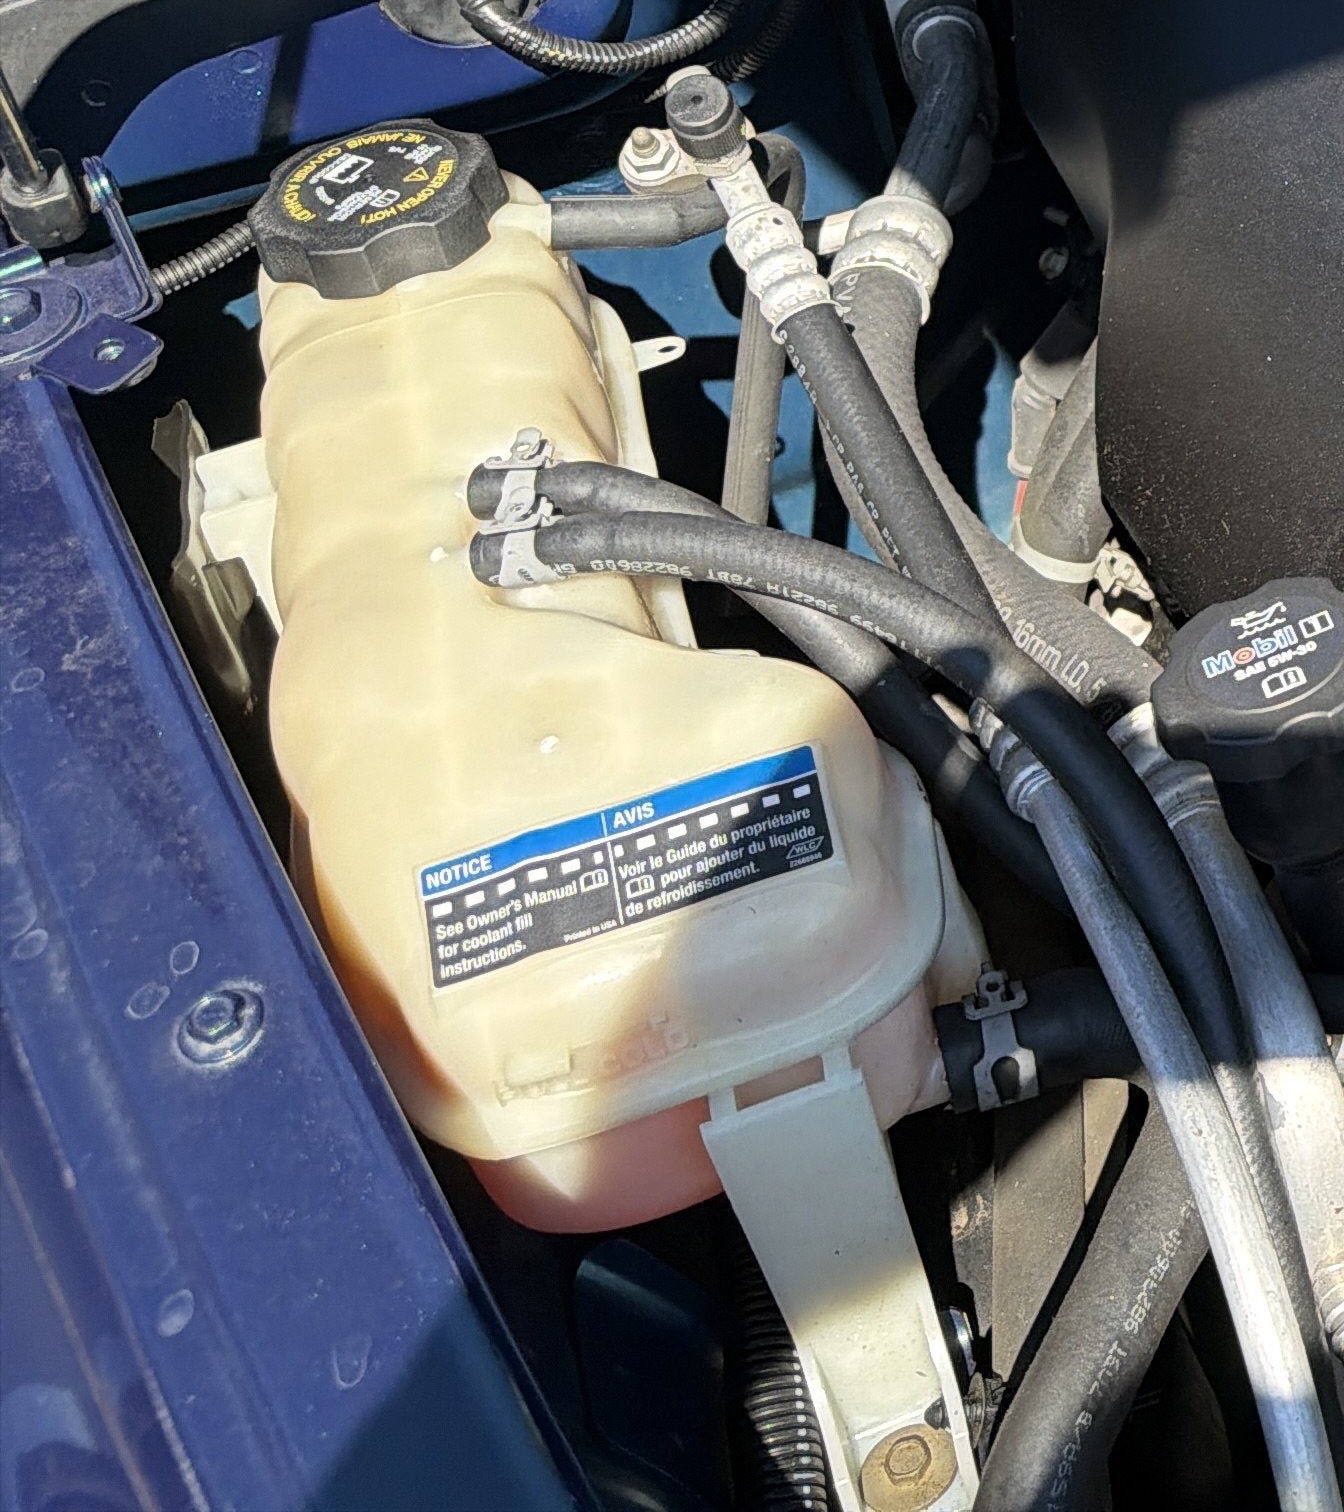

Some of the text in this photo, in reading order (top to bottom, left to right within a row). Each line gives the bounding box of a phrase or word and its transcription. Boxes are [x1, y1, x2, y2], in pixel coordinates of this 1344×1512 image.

[1201, 624, 1298, 679] Mobil
[1233, 640, 1318, 681] SAE 5W-30
[612, 802, 655, 829] AVIS
[618, 807, 811, 879] Voir le Guide du propriétaire
[660, 824, 816, 890] pour ajouter du liquide
[425, 854, 493, 889] NOTICE
[625, 861, 760, 917] de refroidissement.
[435, 882, 577, 940] See Owner's Manual
[437, 914, 533, 960] for coolant fill
[440, 938, 527, 979] instructions.
